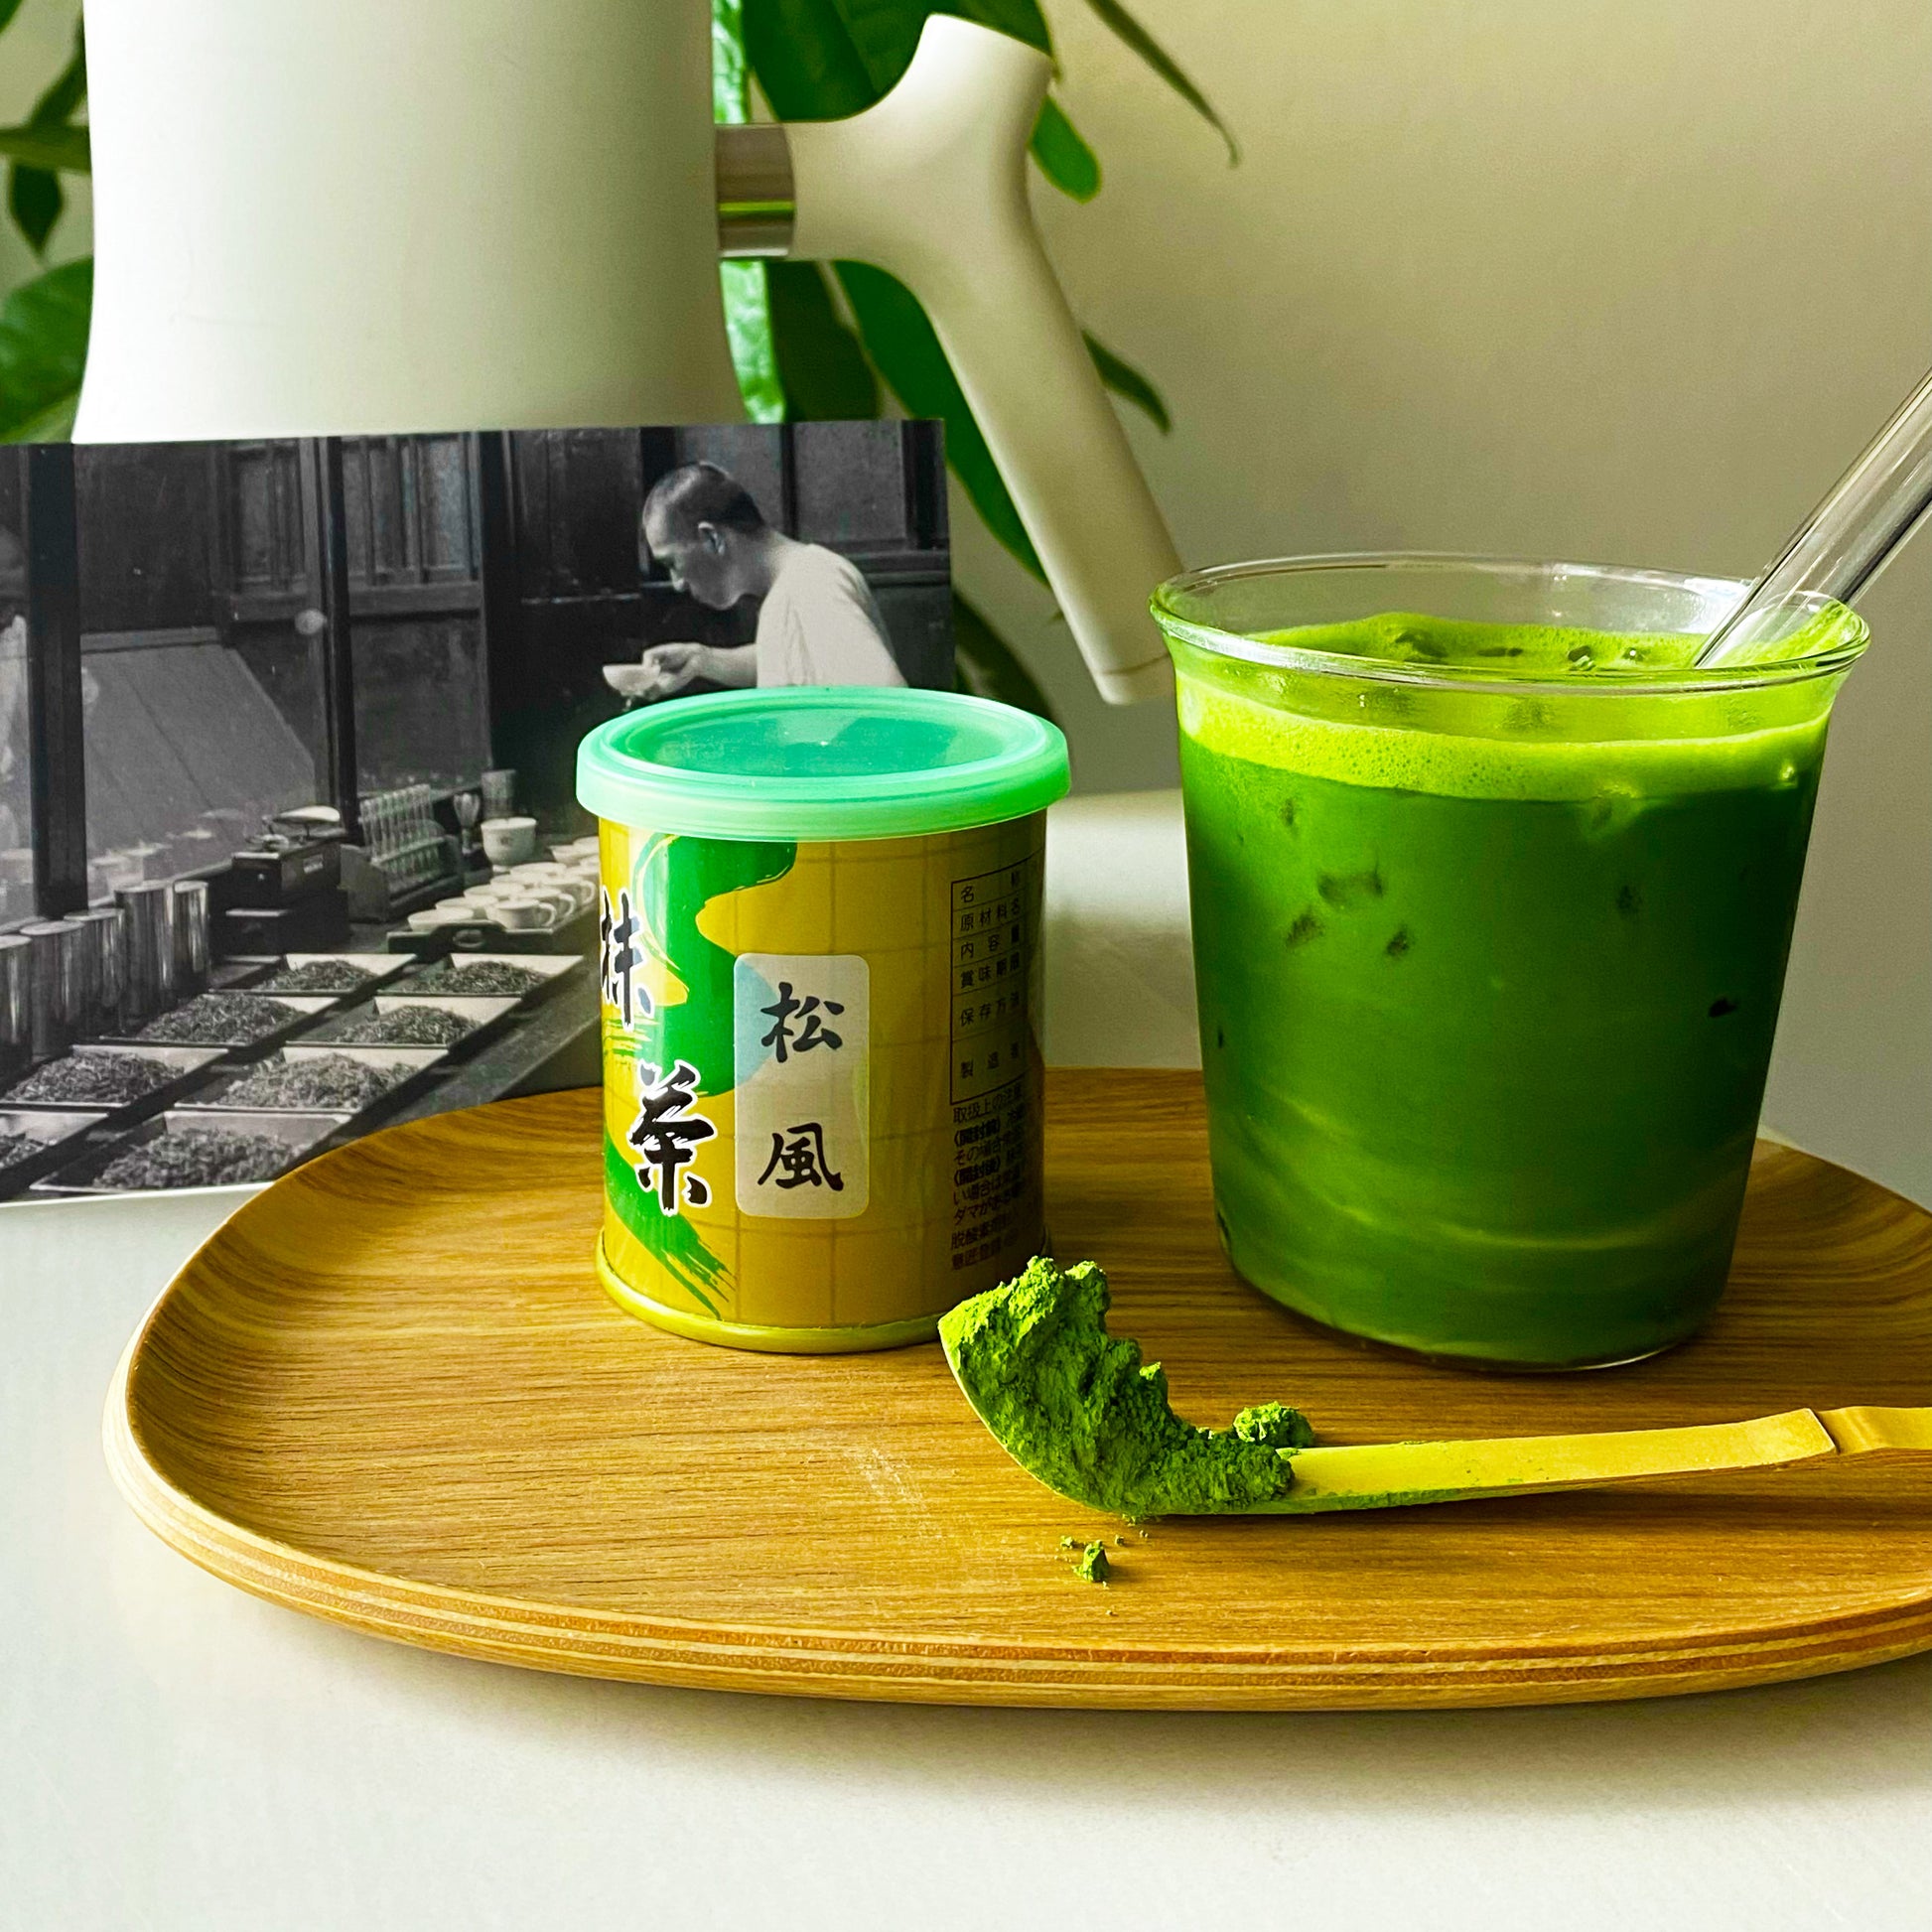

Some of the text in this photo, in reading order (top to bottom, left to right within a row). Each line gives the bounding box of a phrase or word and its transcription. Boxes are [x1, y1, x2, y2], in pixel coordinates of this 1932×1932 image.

[960, 897, 1022, 932] 原材料名
[600, 886, 716, 1213] 抹茶
[758, 982, 846, 1192] 松風
